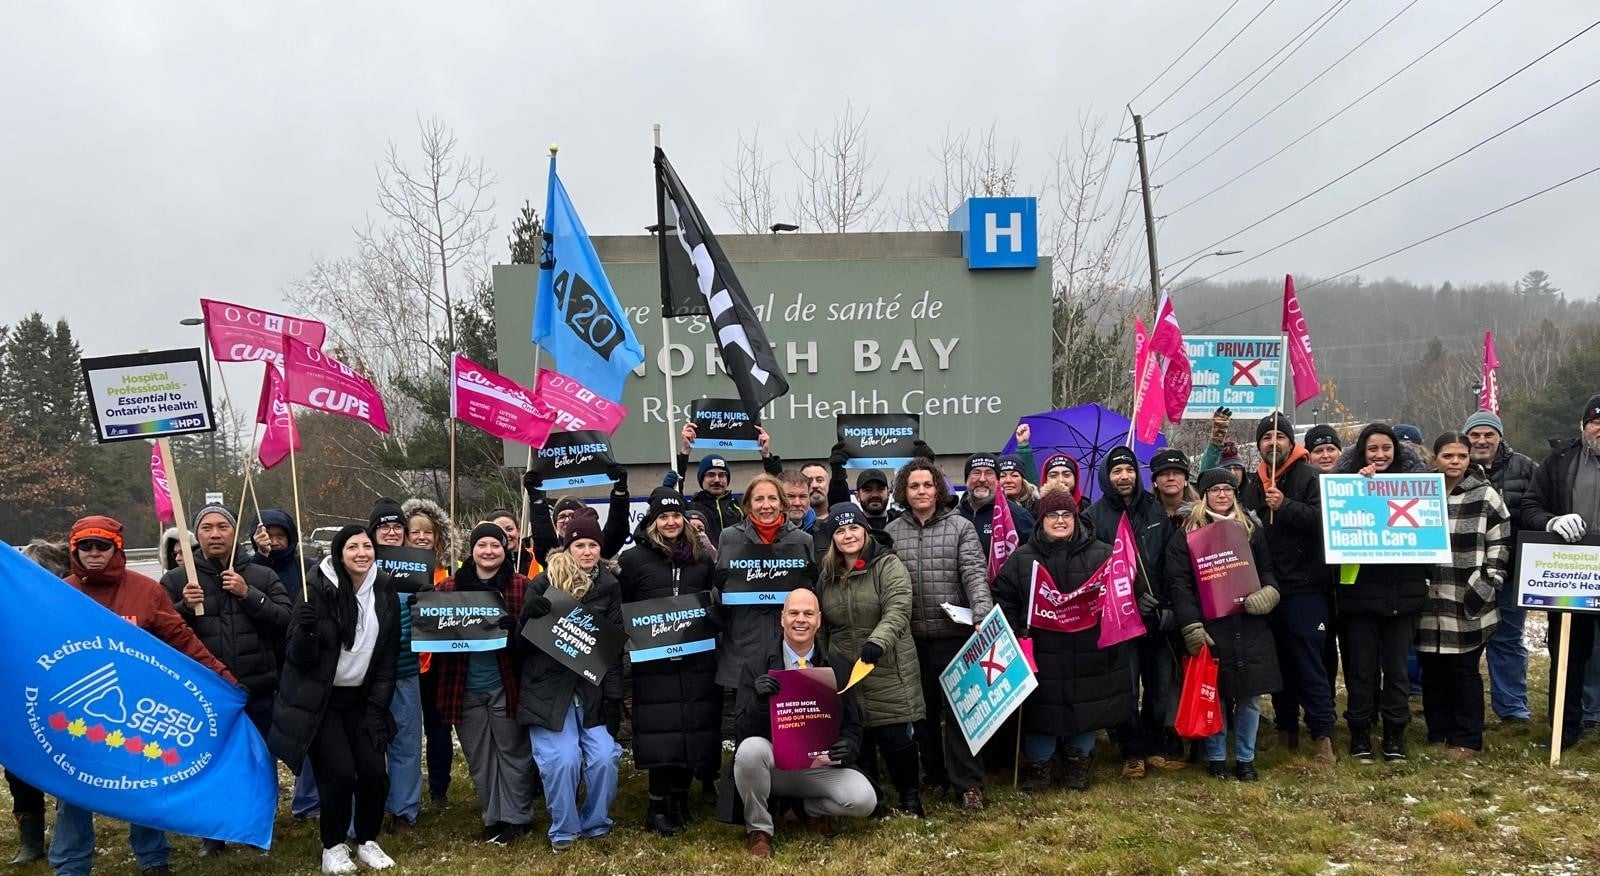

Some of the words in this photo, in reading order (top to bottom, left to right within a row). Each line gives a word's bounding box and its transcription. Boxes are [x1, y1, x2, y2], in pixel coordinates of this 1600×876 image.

[984, 212, 1022, 252] H
[784, 293, 817, 322] de
[827, 292, 902, 321] santé
[911, 290, 943, 319] de
[225, 307, 304, 337] OCHU
[854, 338, 960, 373] BAY
[1216, 342, 1280, 358] PRIVATIZE
[121, 371, 168, 384] Hospital
[107, 383, 180, 396] Professionals
[1223, 387, 1254, 404] Care
[118, 392, 168, 406] Essential
[170, 392, 182, 401] to
[308, 387, 371, 420] CUPE
[790, 390, 889, 419] Health
[901, 389, 1002, 415] Centre
[105, 405, 157, 418] Ontario's
[158, 401, 198, 413] Health!
[696, 411, 722, 419] MORE
[178, 418, 201, 429] HPD
[709, 419, 728, 430] Better
[728, 418, 744, 429] Care
[844, 427, 873, 436] MORE
[875, 427, 913, 436] NURSES
[860, 436, 880, 448] Better
[880, 434, 899, 446] Care
[537, 447, 567, 458] MORE
[568, 443, 608, 454] NURSES
[554, 455, 575, 469] Better
[575, 451, 594, 465] Care
[1327, 480, 1365, 497] Don't
[1367, 480, 1440, 497] PRIVATIZE
[661, 498, 679, 506] ONA
[1328, 498, 1347, 508] Our
[1329, 510, 1376, 527] Public
[1331, 529, 1379, 547] Health
[1381, 529, 1417, 547] Care
[729, 559, 760, 569] MORE
[763, 559, 805, 569] NURSES
[1552, 551, 1598, 561] Hospital
[385, 560, 427, 572] NURSES
[390, 567, 410, 578] Care
[746, 568, 768, 581] Better
[768, 567, 789, 579] Care
[1527, 578, 1577, 589] Ontario's
[1542, 570, 1592, 580] Essential
[758, 593, 776, 601] ONA
[420, 607, 453, 617] MORE
[456, 607, 500, 616] NURSES
[565, 606, 600, 632] Better
[631, 613, 664, 627] MORE
[665, 608, 706, 622] NURSES
[437, 616, 461, 630] Better
[461, 614, 483, 627] Care
[651, 624, 673, 637] Better
[673, 619, 692, 632] Care
[551, 625, 592, 654] STAFFING
[557, 616, 597, 646] FUNDING
[555, 639, 579, 659] CARE
[944, 660, 967, 692] Don't
[963, 614, 1004, 671] PRIVATIZE
[583, 669, 597, 682] ONA
[36, 636, 103, 671] Retired
[108, 638, 181, 681] Members
[183, 679, 218, 738] Division
[956, 683, 983, 718] Public
[963, 699, 992, 735] Health
[987, 677, 1012, 707] Care
[136, 697, 203, 733] OPSEU
[25, 686, 53, 755] Division
[53, 754, 75, 776] des
[78, 769, 158, 790] membres
[162, 751, 213, 785] retraités
[127, 713, 195, 748] SEFPO
